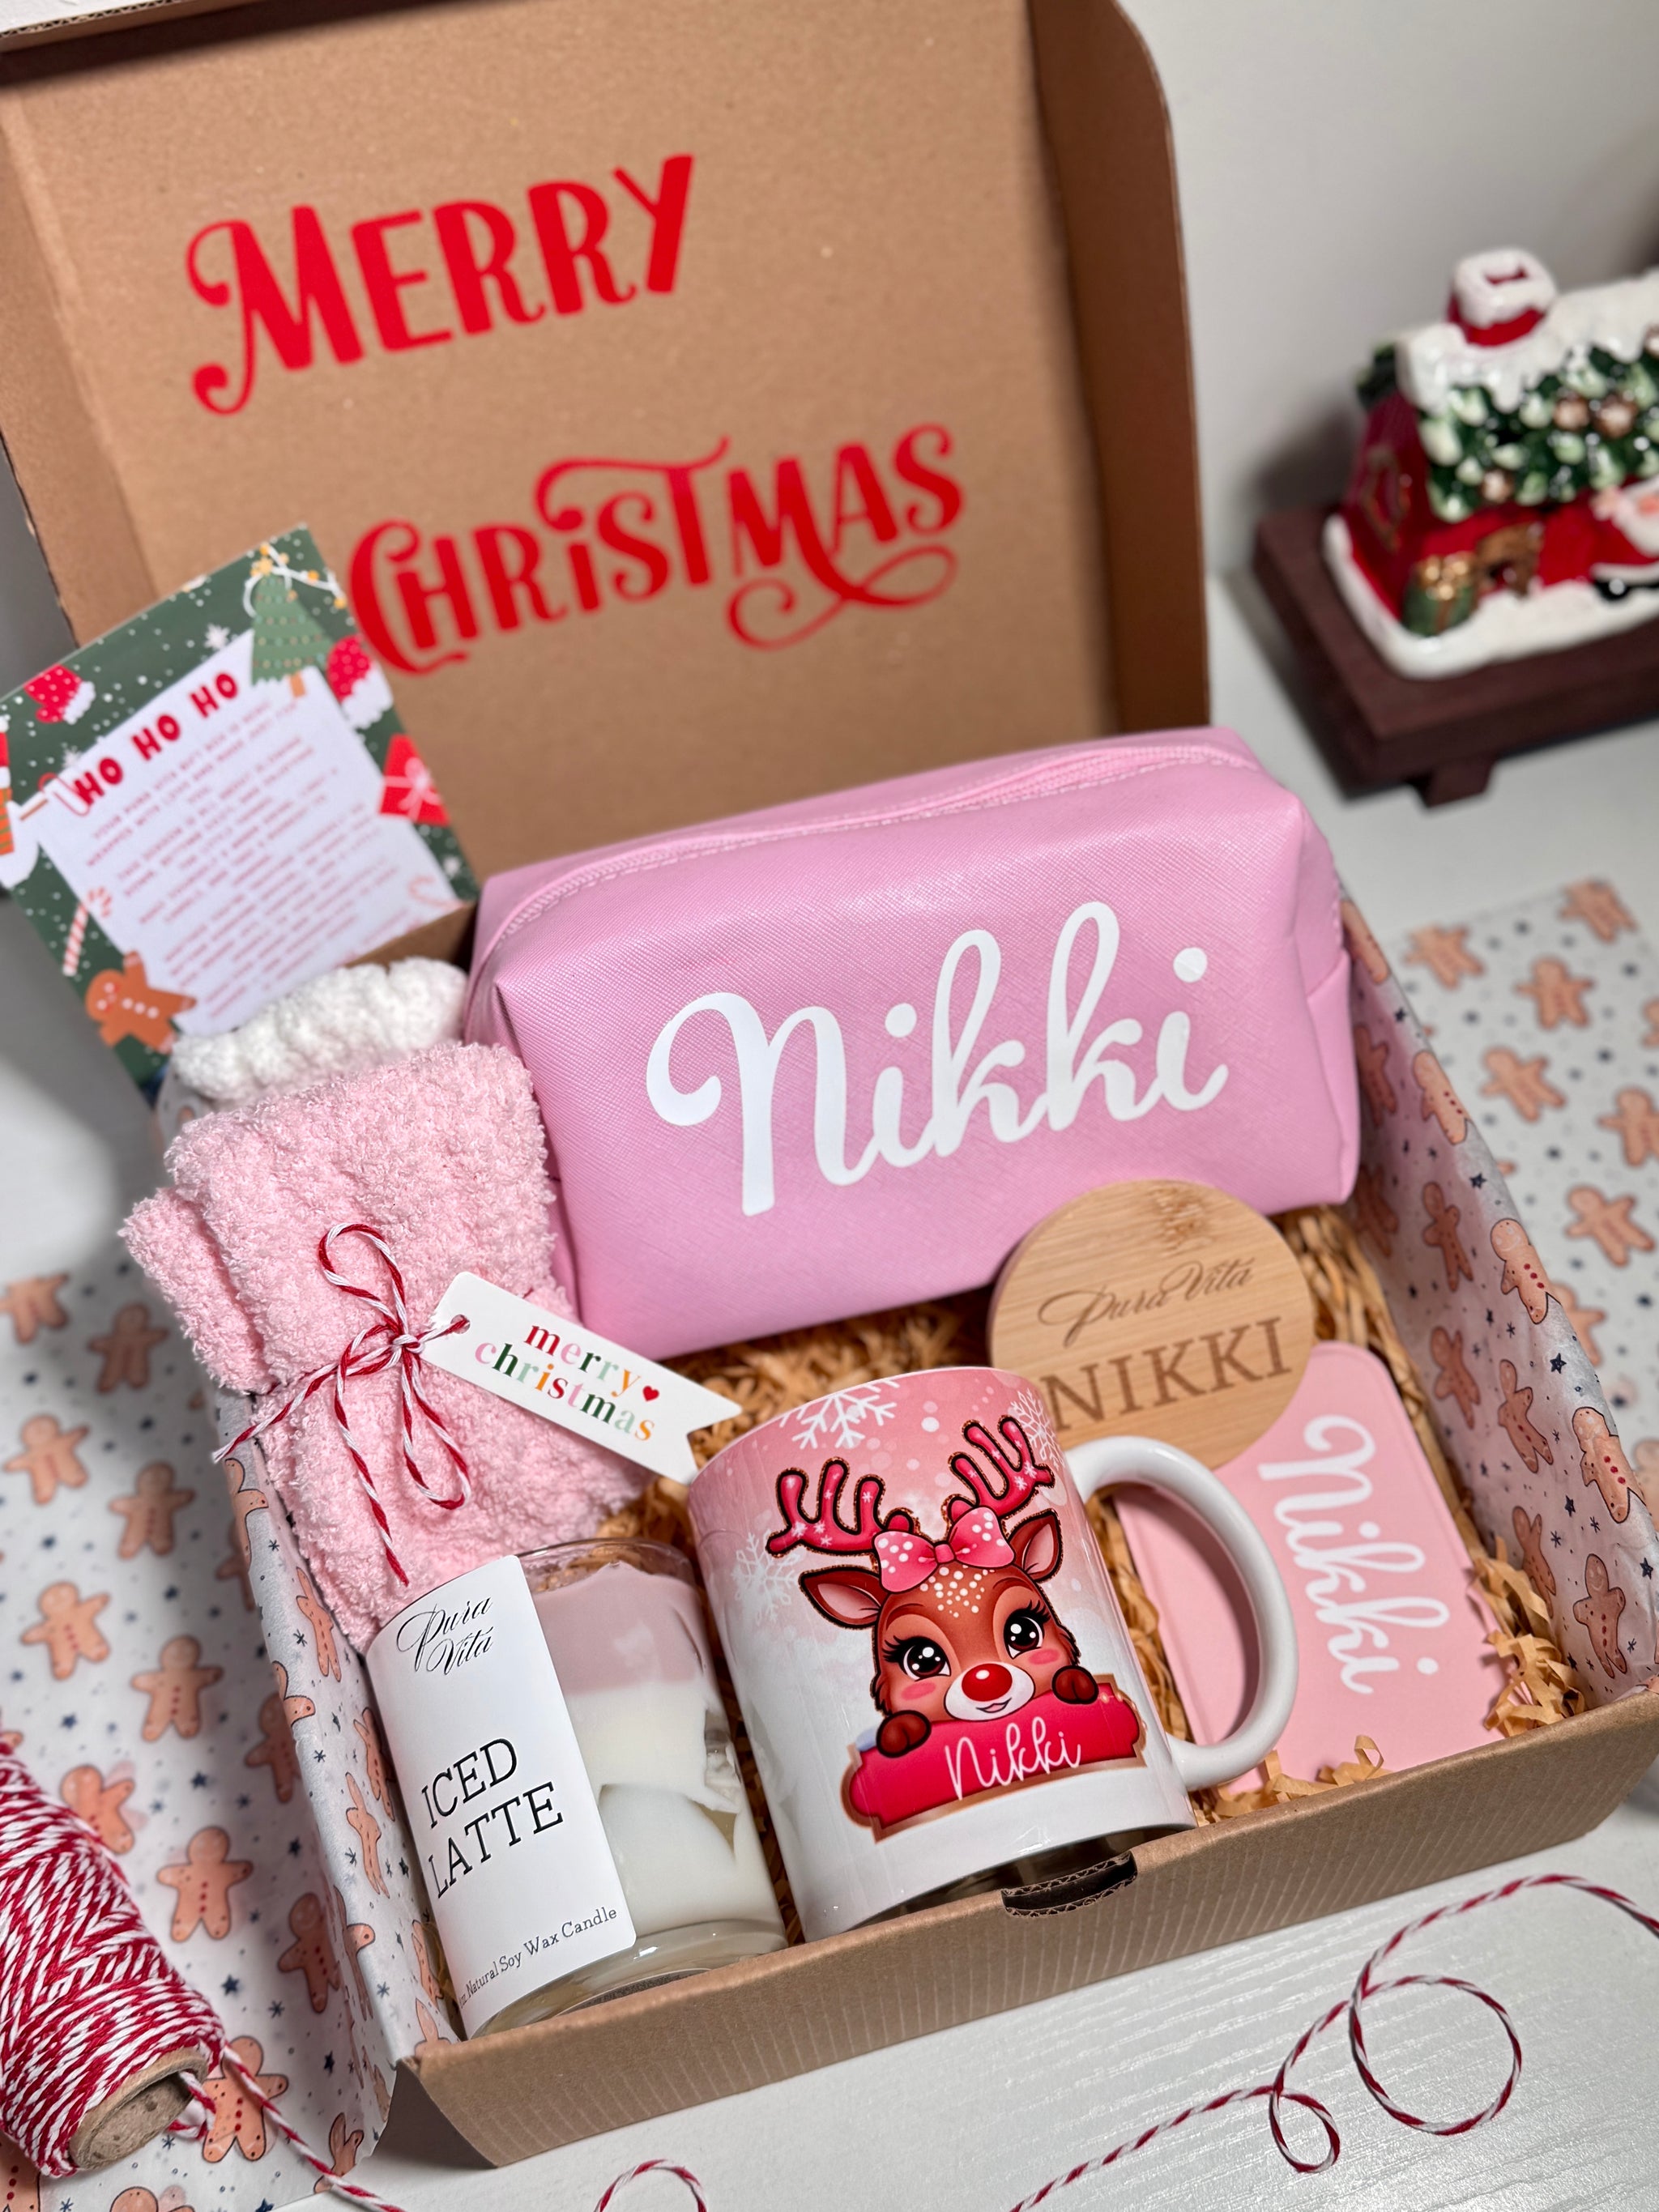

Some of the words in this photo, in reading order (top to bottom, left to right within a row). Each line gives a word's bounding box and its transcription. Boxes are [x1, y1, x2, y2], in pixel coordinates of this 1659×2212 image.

[186, 154, 694, 416] MERRY
[74, 757, 123, 806] HO
[131, 714, 181, 761] HO
[190, 673, 238, 718] HO
[646, 901, 1229, 1217] Nikki
[523, 1324, 642, 1398] merry
[1037, 1285, 1171, 1349] Pura
[475, 1341, 655, 1441] christmas
[1040, 1316, 1292, 1431] NIKKI
[1258, 1414, 1451, 1695] Nikki
[420, 1737, 518, 1829] ICED
[945, 1716, 1081, 1801] Nikki
[428, 1781, 563, 1899] LATTE
[466, 1961, 499, 1999] Natural
[499, 1952, 522, 1971] Soy
[523, 1936, 559, 1955] Wax
[561, 1907, 617, 1937] Candle
